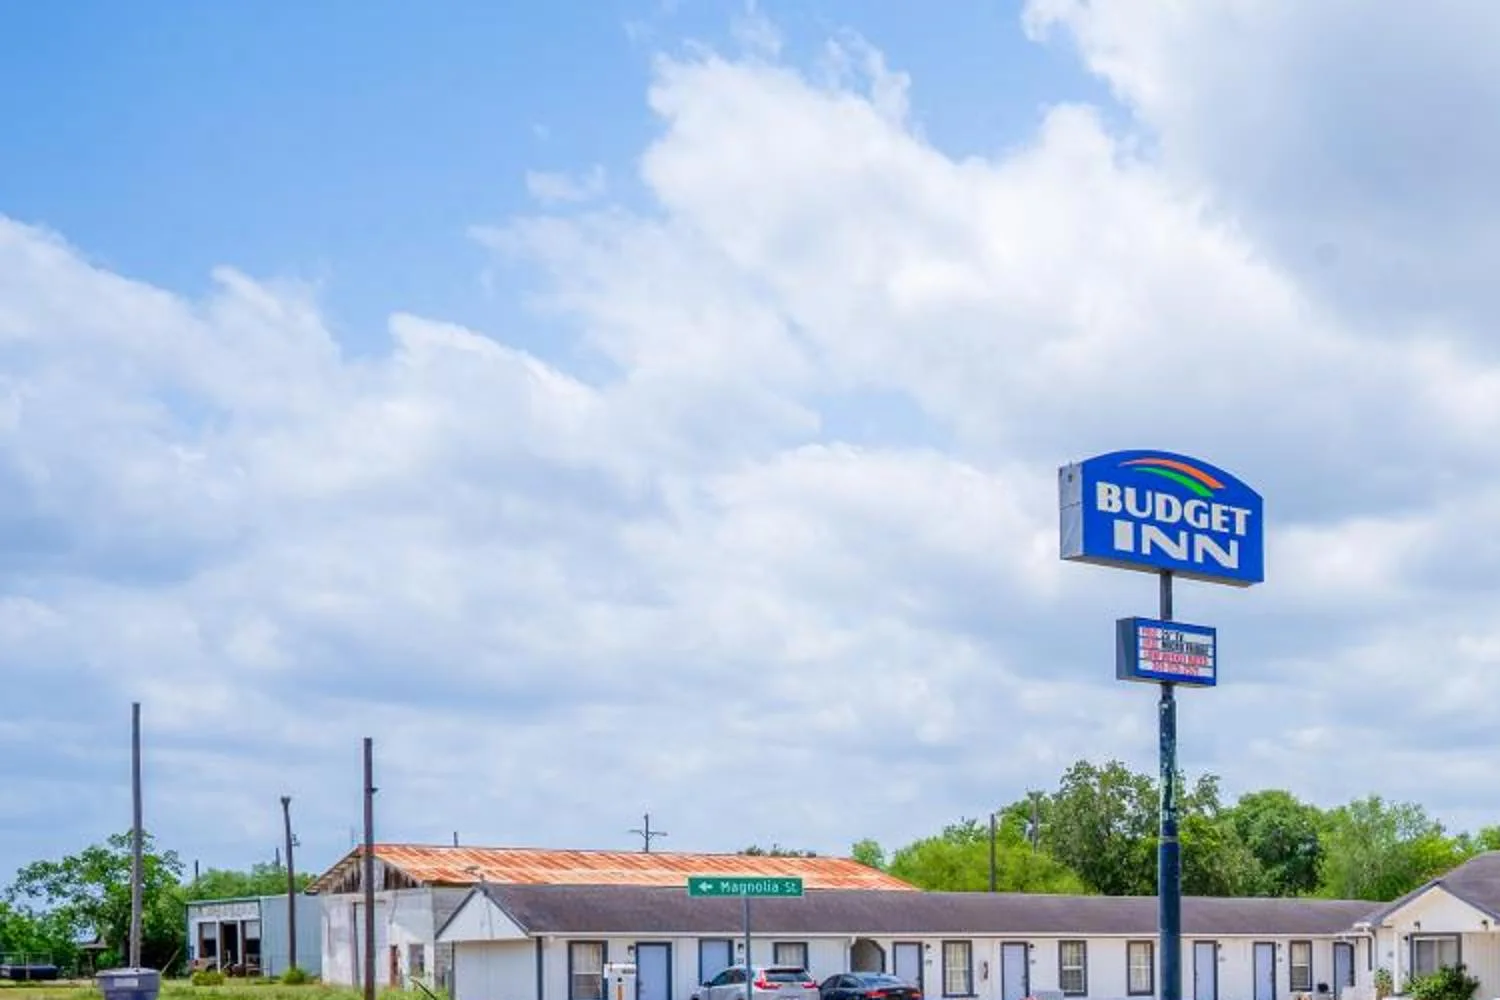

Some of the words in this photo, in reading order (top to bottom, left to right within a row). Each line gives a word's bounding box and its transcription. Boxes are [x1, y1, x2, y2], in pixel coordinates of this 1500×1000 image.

[1096, 482, 1252, 536] BUDGET
[1113, 519, 1239, 569] INN
[720, 880, 779, 893] Magnolia
[785, 881, 797, 893] St
